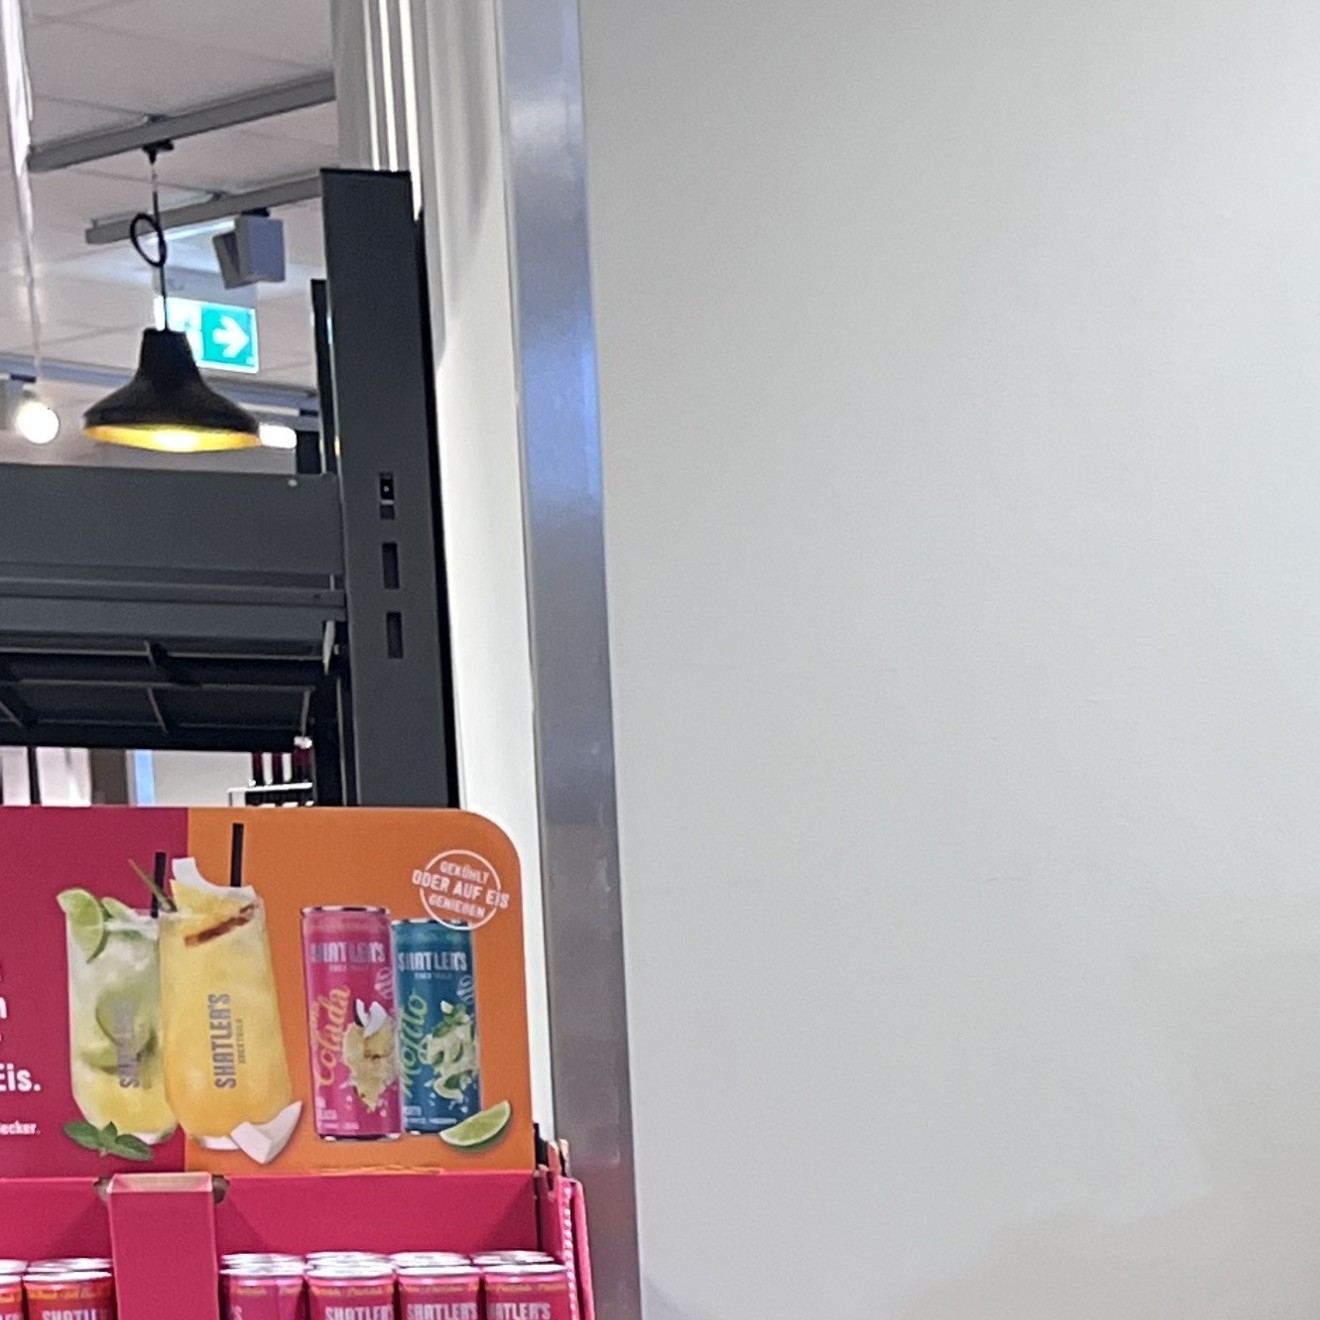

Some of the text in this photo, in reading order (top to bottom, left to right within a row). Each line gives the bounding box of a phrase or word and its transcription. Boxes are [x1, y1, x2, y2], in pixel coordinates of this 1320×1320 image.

[412, 869, 510, 909] ODER AUF EIS
[208, 993, 238, 1089] SHATLER'S
